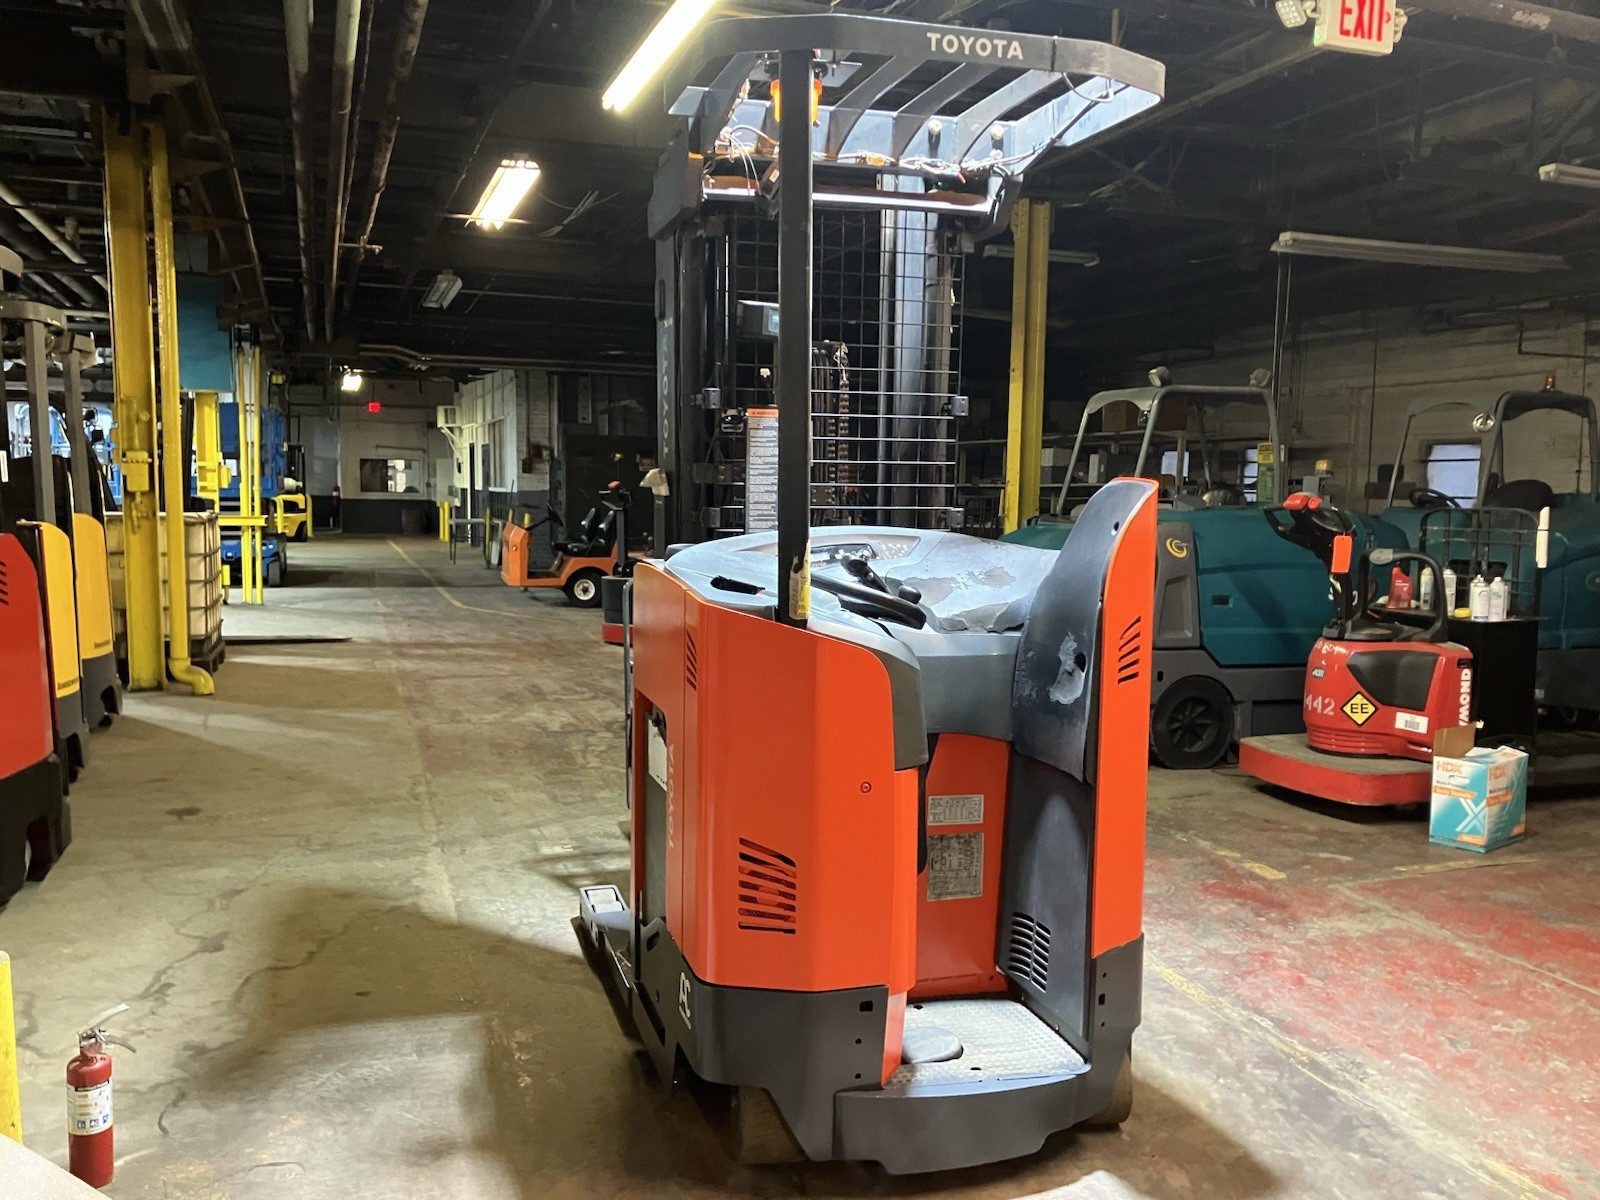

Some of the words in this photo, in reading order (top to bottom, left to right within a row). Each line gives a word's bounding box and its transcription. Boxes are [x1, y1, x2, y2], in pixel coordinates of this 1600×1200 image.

[1339, 0, 1385, 42] EXIT
[926, 31, 1024, 60] TOYOTA
[1350, 703, 1370, 714] EE
[1436, 760, 1463, 774] HDX
